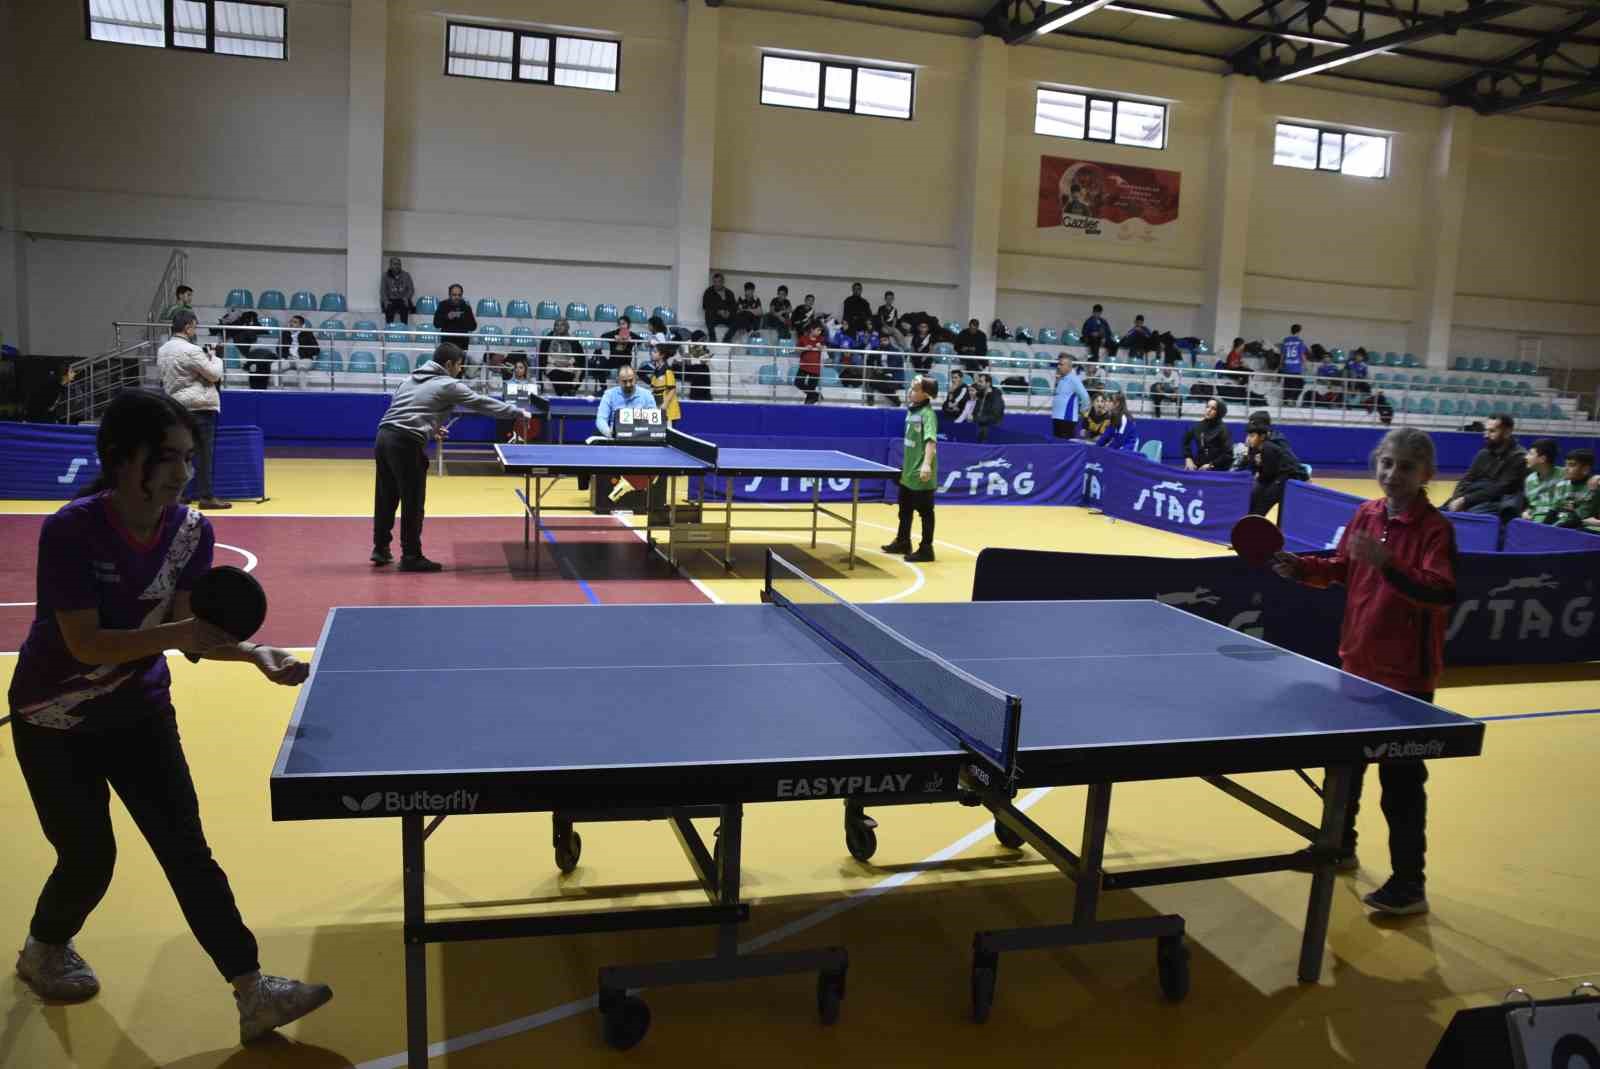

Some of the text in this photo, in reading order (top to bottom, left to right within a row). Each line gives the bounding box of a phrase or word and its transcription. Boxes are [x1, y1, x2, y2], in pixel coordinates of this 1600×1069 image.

[936, 470, 1035, 496] STAG
[1133, 488, 1206, 526] STAG
[1445, 596, 1595, 640] STAG
[1389, 739, 1448, 758] Butterfly
[776, 772, 913, 798] EASYPLAY
[384, 788, 480, 812] Butterfly
